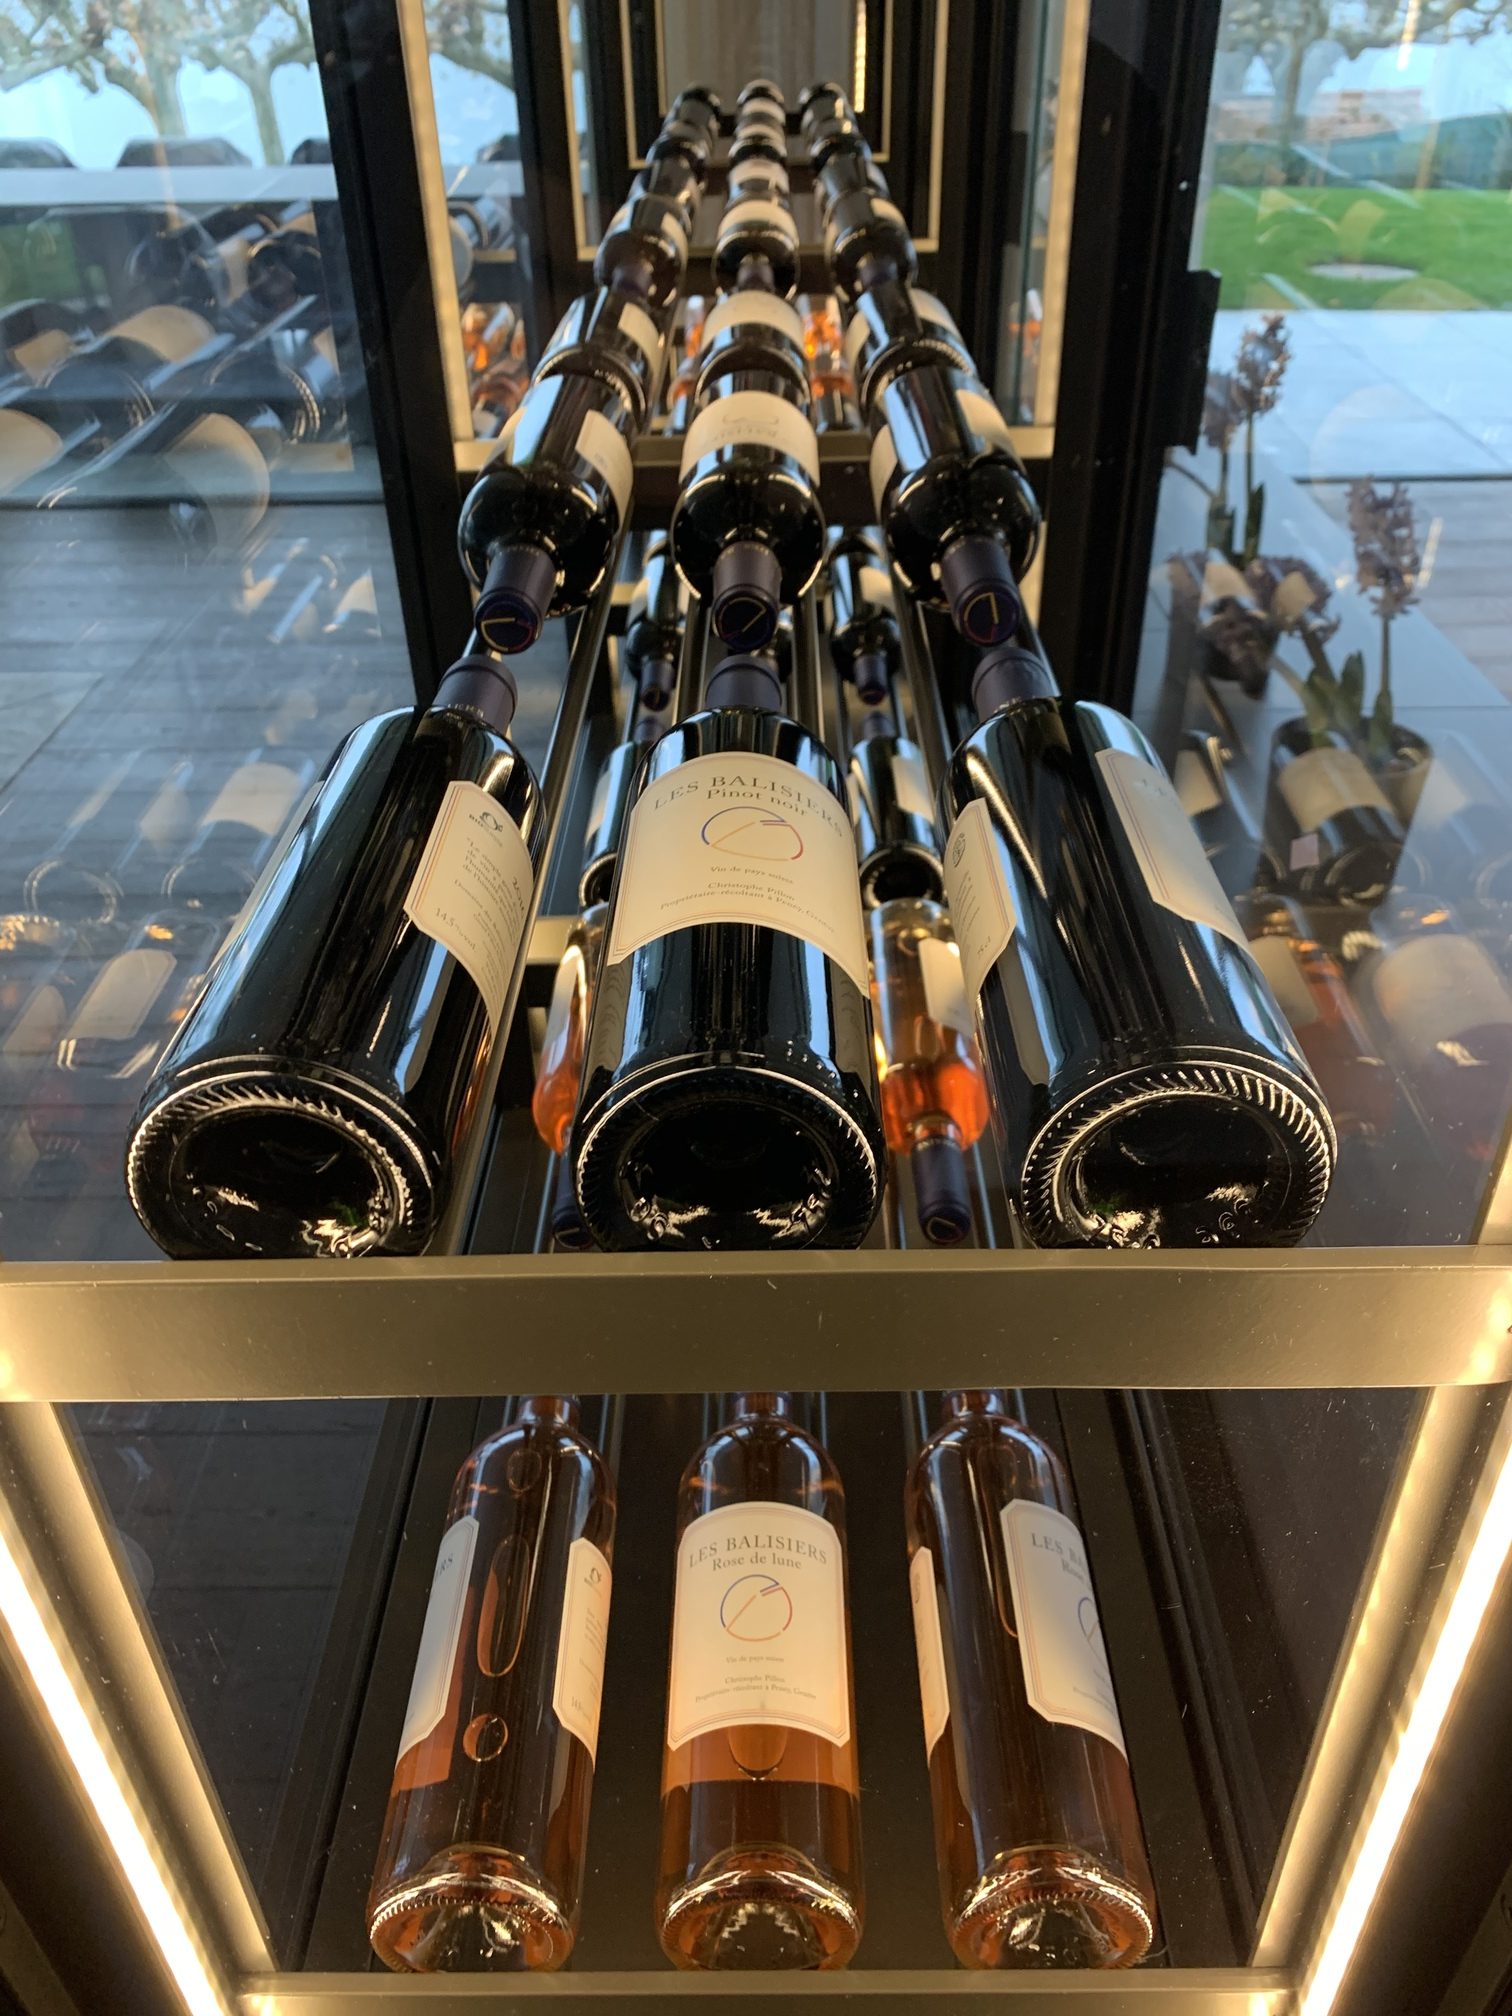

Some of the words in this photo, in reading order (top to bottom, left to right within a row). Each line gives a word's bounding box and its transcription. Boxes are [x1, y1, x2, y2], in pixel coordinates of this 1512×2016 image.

[654, 780, 699, 811] LES
[711, 775, 844, 838] BALISIERS
[706, 789, 762, 800] Pinot
[770, 796, 808, 817] noir
[744, 867, 766, 876] pays
[690, 1541, 718, 1569] LES
[726, 1534, 828, 1565] BALISIERS
[1031, 1532, 1063, 1555] LES
[712, 1555, 745, 1572] Rose
[750, 1551, 767, 1565] de
[772, 1552, 802, 1570] lune
